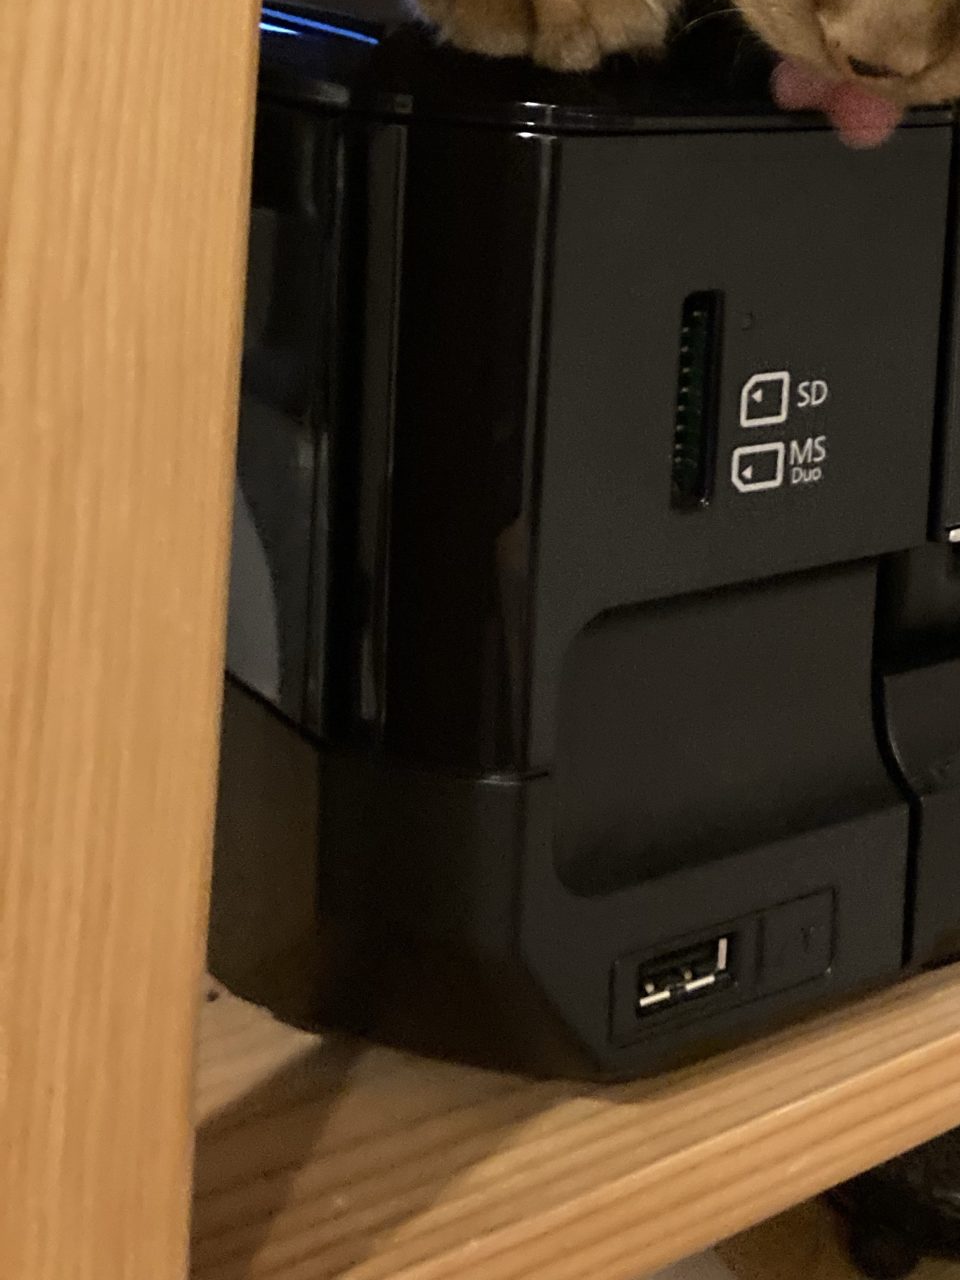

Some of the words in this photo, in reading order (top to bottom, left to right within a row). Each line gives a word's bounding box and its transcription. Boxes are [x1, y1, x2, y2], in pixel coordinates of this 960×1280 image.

[797, 380, 828, 407] SD
[789, 436, 827, 465] MS
[791, 466, 822, 484] Duo
